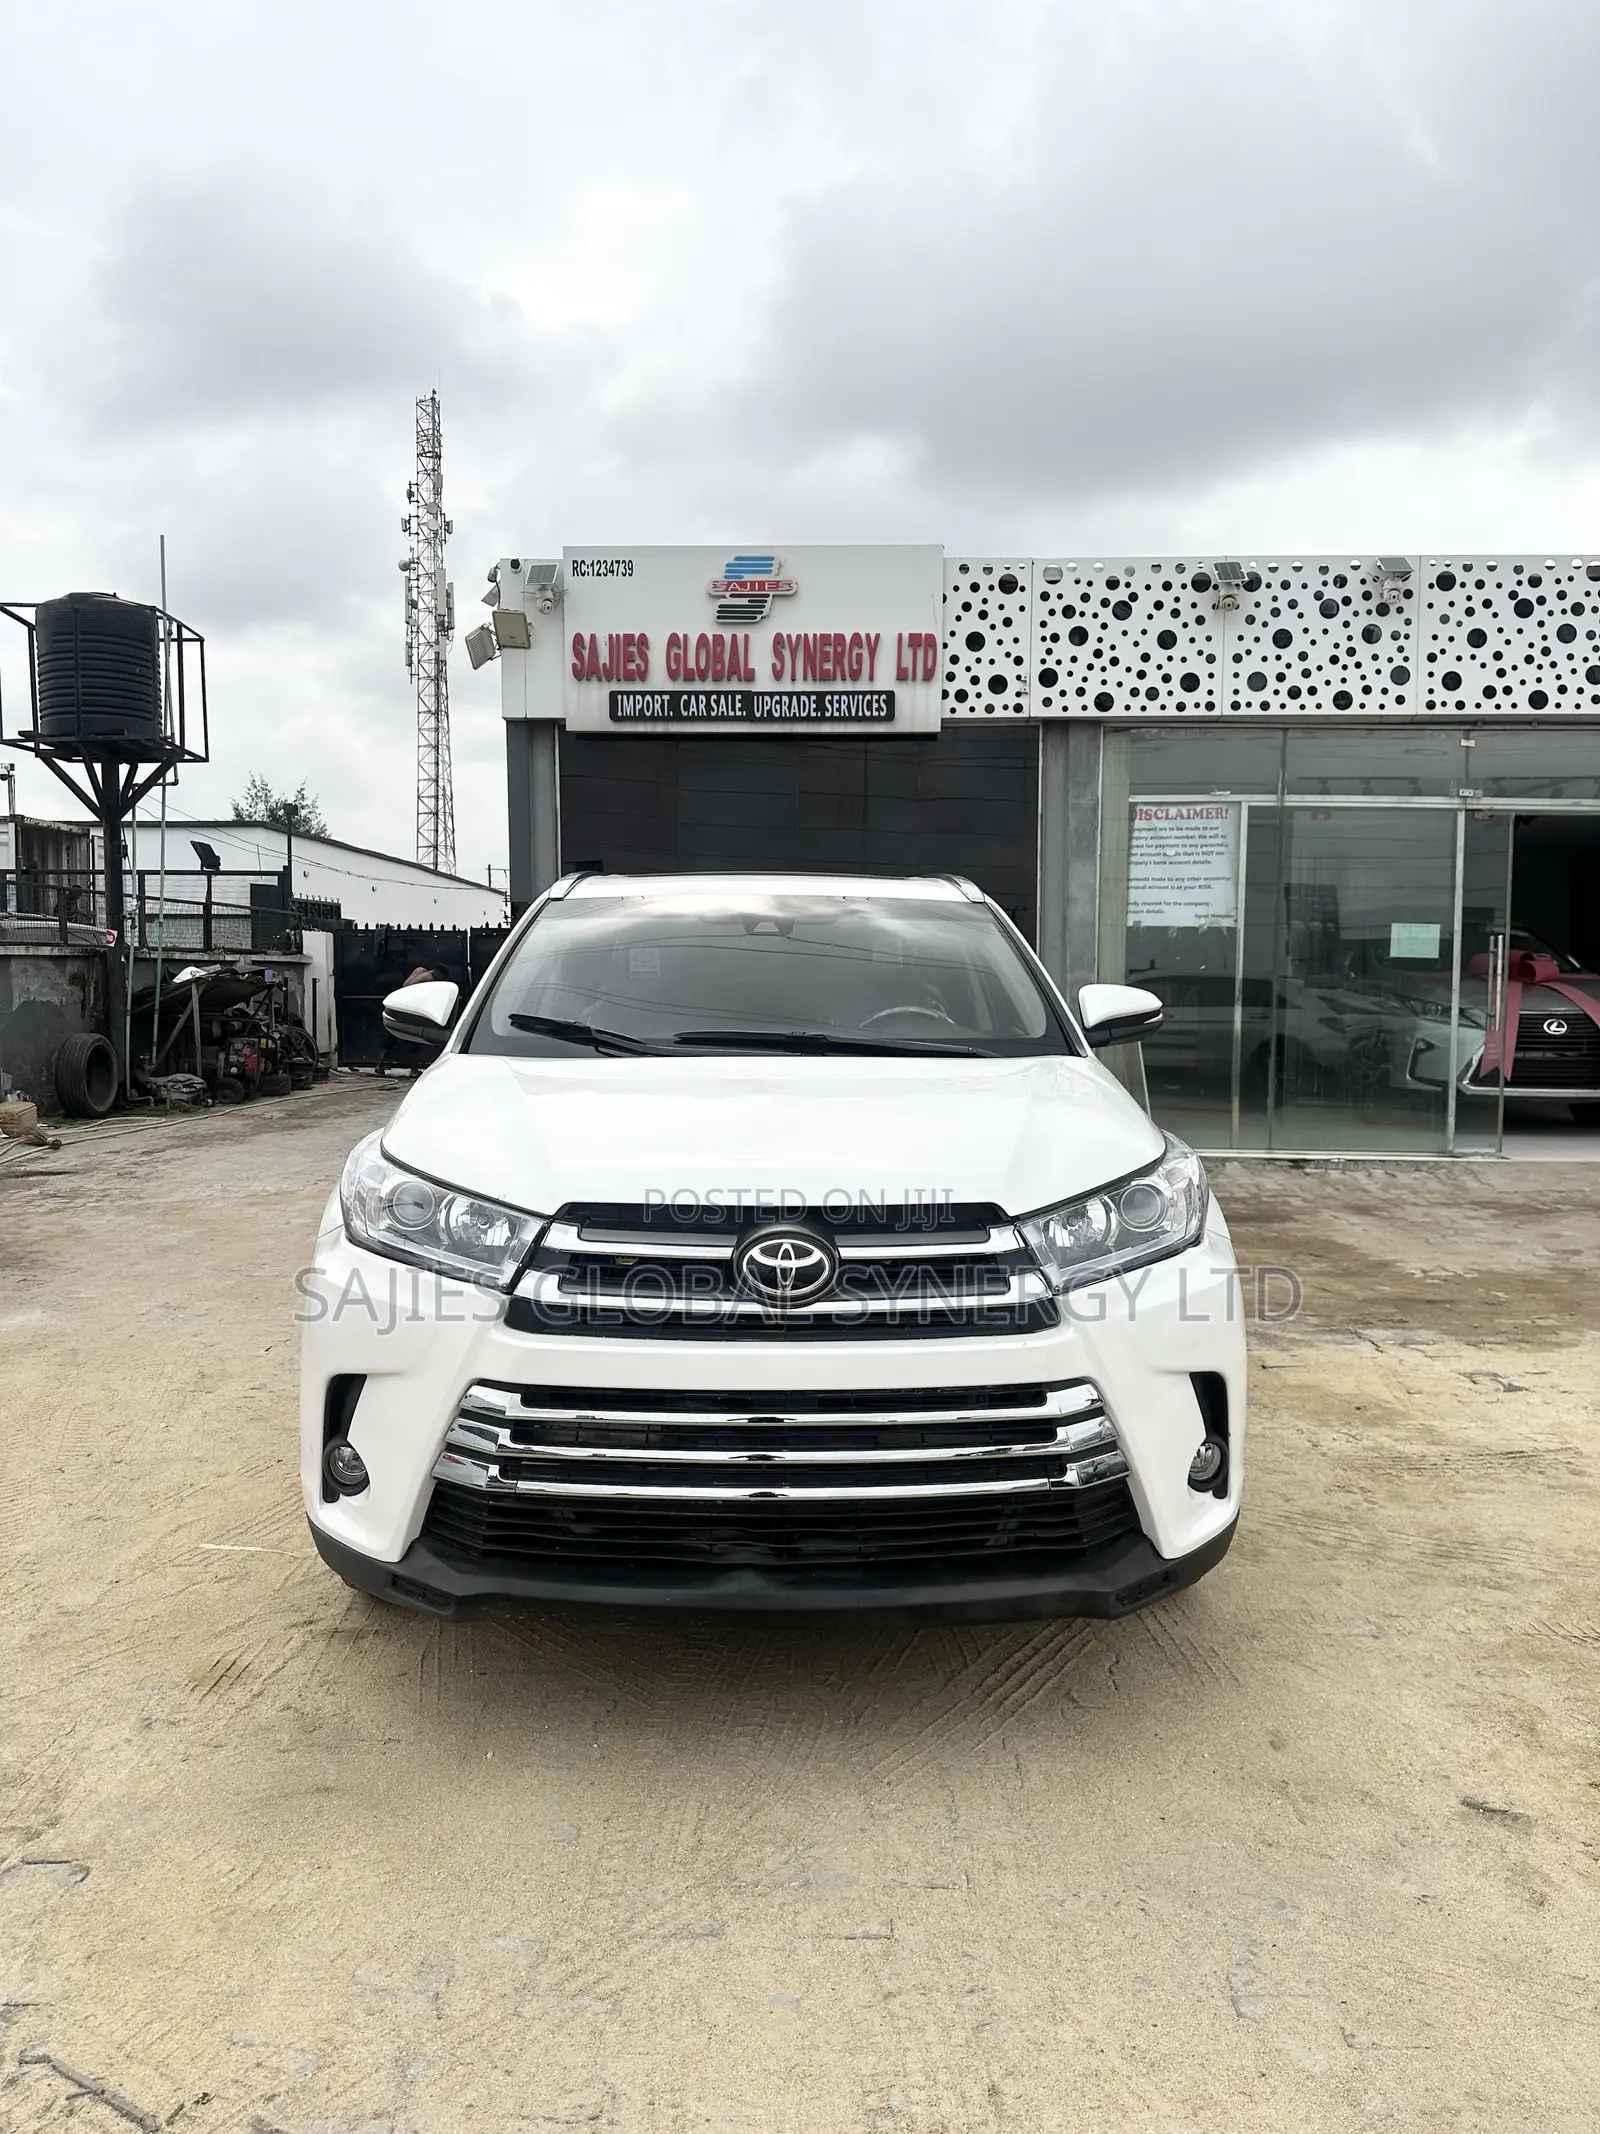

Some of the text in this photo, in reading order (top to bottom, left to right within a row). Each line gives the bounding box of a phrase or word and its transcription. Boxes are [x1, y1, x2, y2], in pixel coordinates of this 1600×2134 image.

[571, 559, 634, 578] RC:1234739
[711, 580, 795, 592] SAJIES
[571, 632, 938, 682] SAJIES GLOBAL SYNERGY LTD
[617, 694, 888, 718] IMPORT. CAR SALE. UPGRADE. SERVICES
